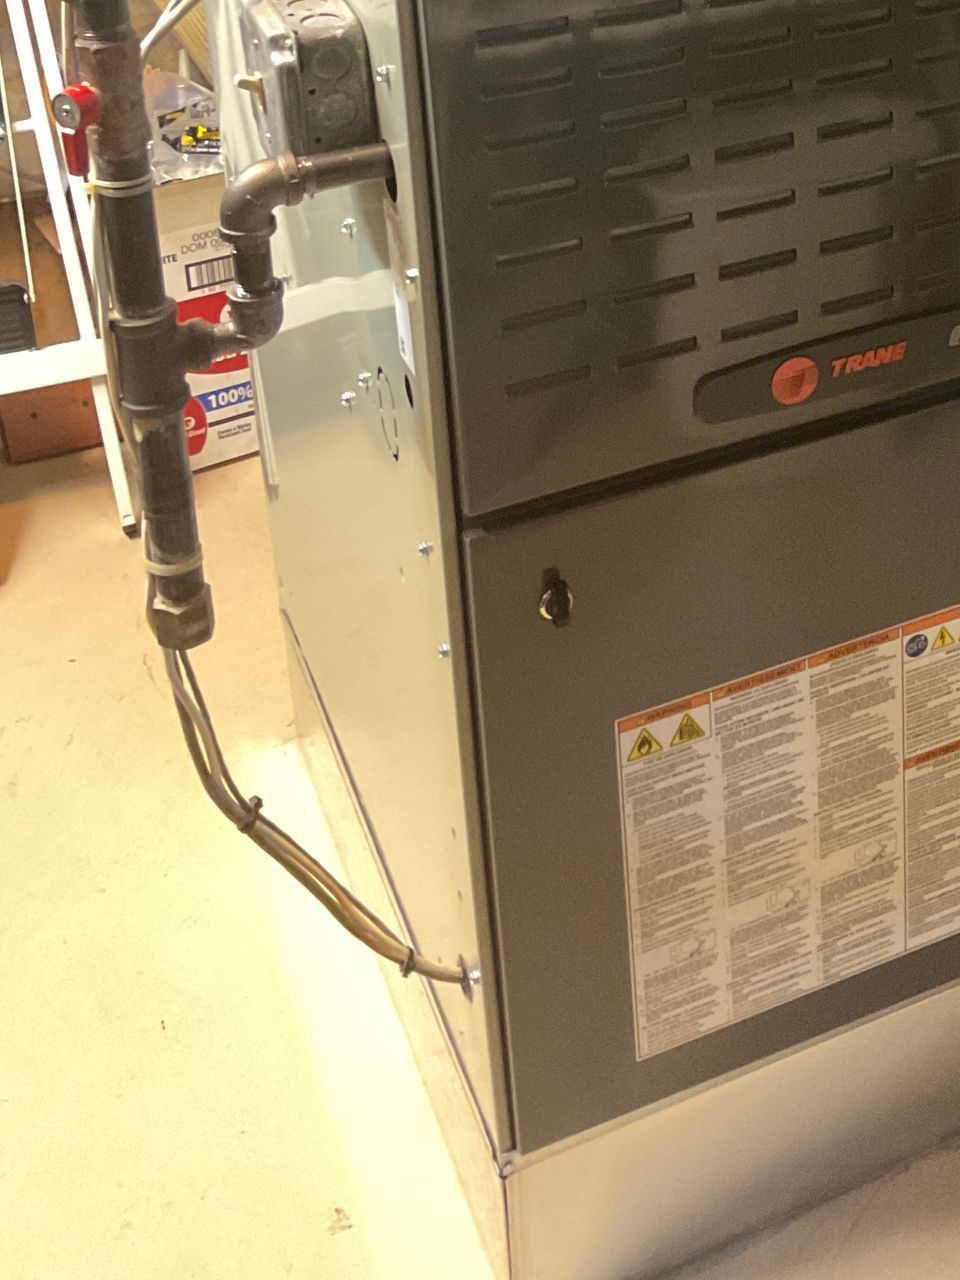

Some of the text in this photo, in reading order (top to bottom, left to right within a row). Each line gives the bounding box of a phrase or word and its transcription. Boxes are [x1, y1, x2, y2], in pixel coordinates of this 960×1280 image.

[181, 240, 207, 254] DOM
[162, 254, 178, 265] ITE
[832, 340, 908, 378] TRANE
[207, 384, 254, 408] 100%
